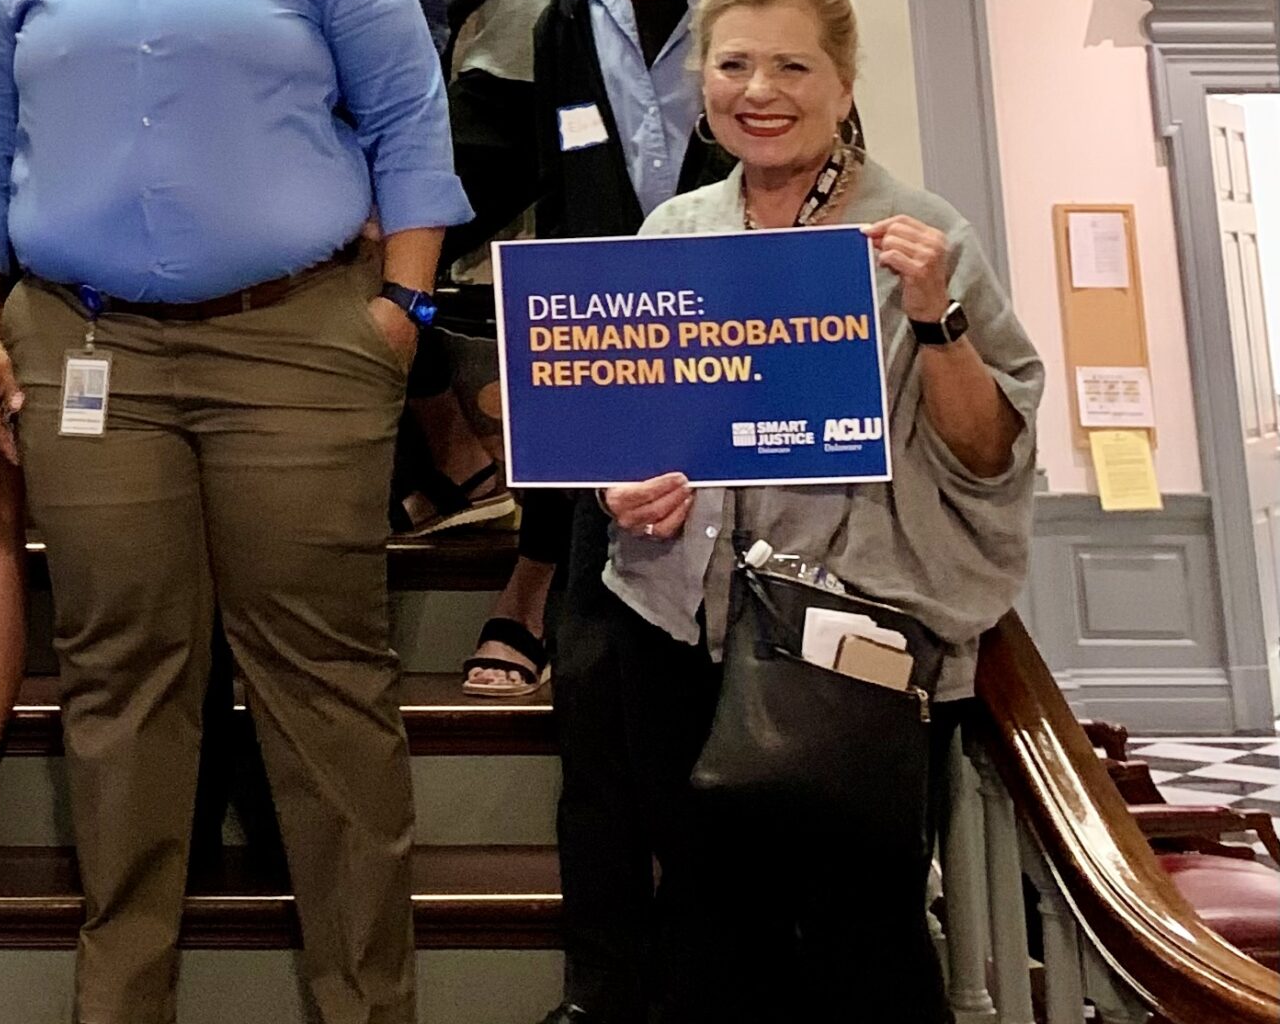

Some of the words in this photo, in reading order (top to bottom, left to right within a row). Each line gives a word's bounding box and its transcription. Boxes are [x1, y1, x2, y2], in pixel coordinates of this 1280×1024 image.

[528, 290, 704, 321] DELAWARE:
[529, 323, 670, 352] DEMAND
[678, 314, 870, 348] PROBATION
[532, 358, 666, 386] REFORM
[674, 356, 762, 384] NOW.
[757, 420, 808, 434] SMART
[758, 432, 815, 446] JUSTICE
[823, 417, 882, 442] ACLU
